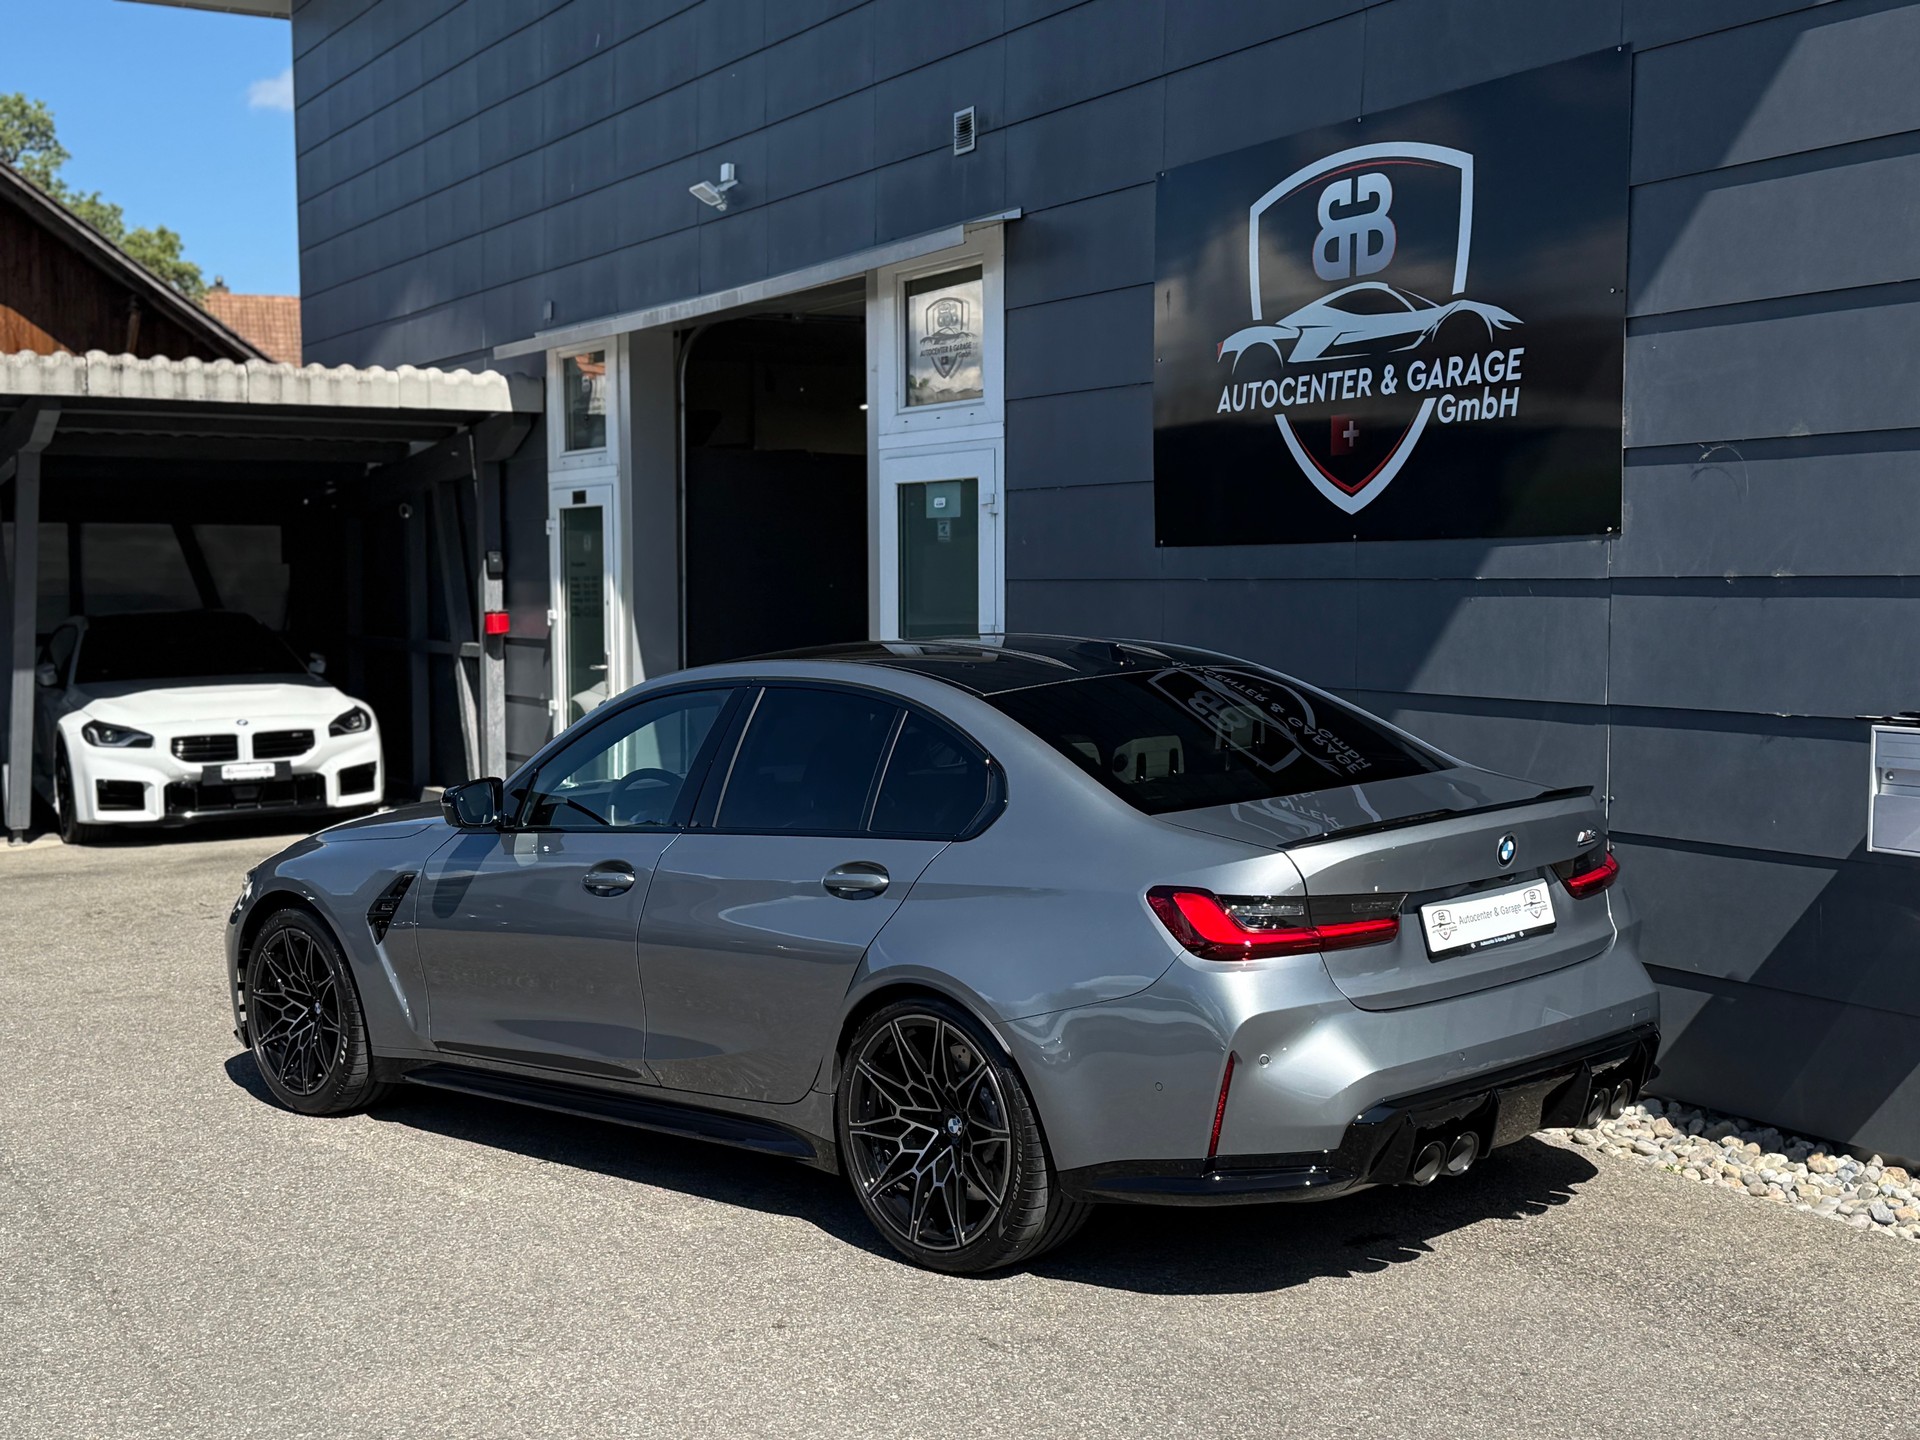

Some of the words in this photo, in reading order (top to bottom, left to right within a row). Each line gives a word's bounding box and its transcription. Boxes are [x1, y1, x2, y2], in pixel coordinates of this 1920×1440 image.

[1217, 367, 1373, 414] AUTOCENTER
[1380, 364, 1398, 395] &
[1406, 347, 1525, 392] GARAGE
[1437, 386, 1520, 424] GmbH
[1459, 911, 1492, 924] Autocenter
[1494, 906, 1499, 917] &
[1500, 904, 1521, 915] Garage
